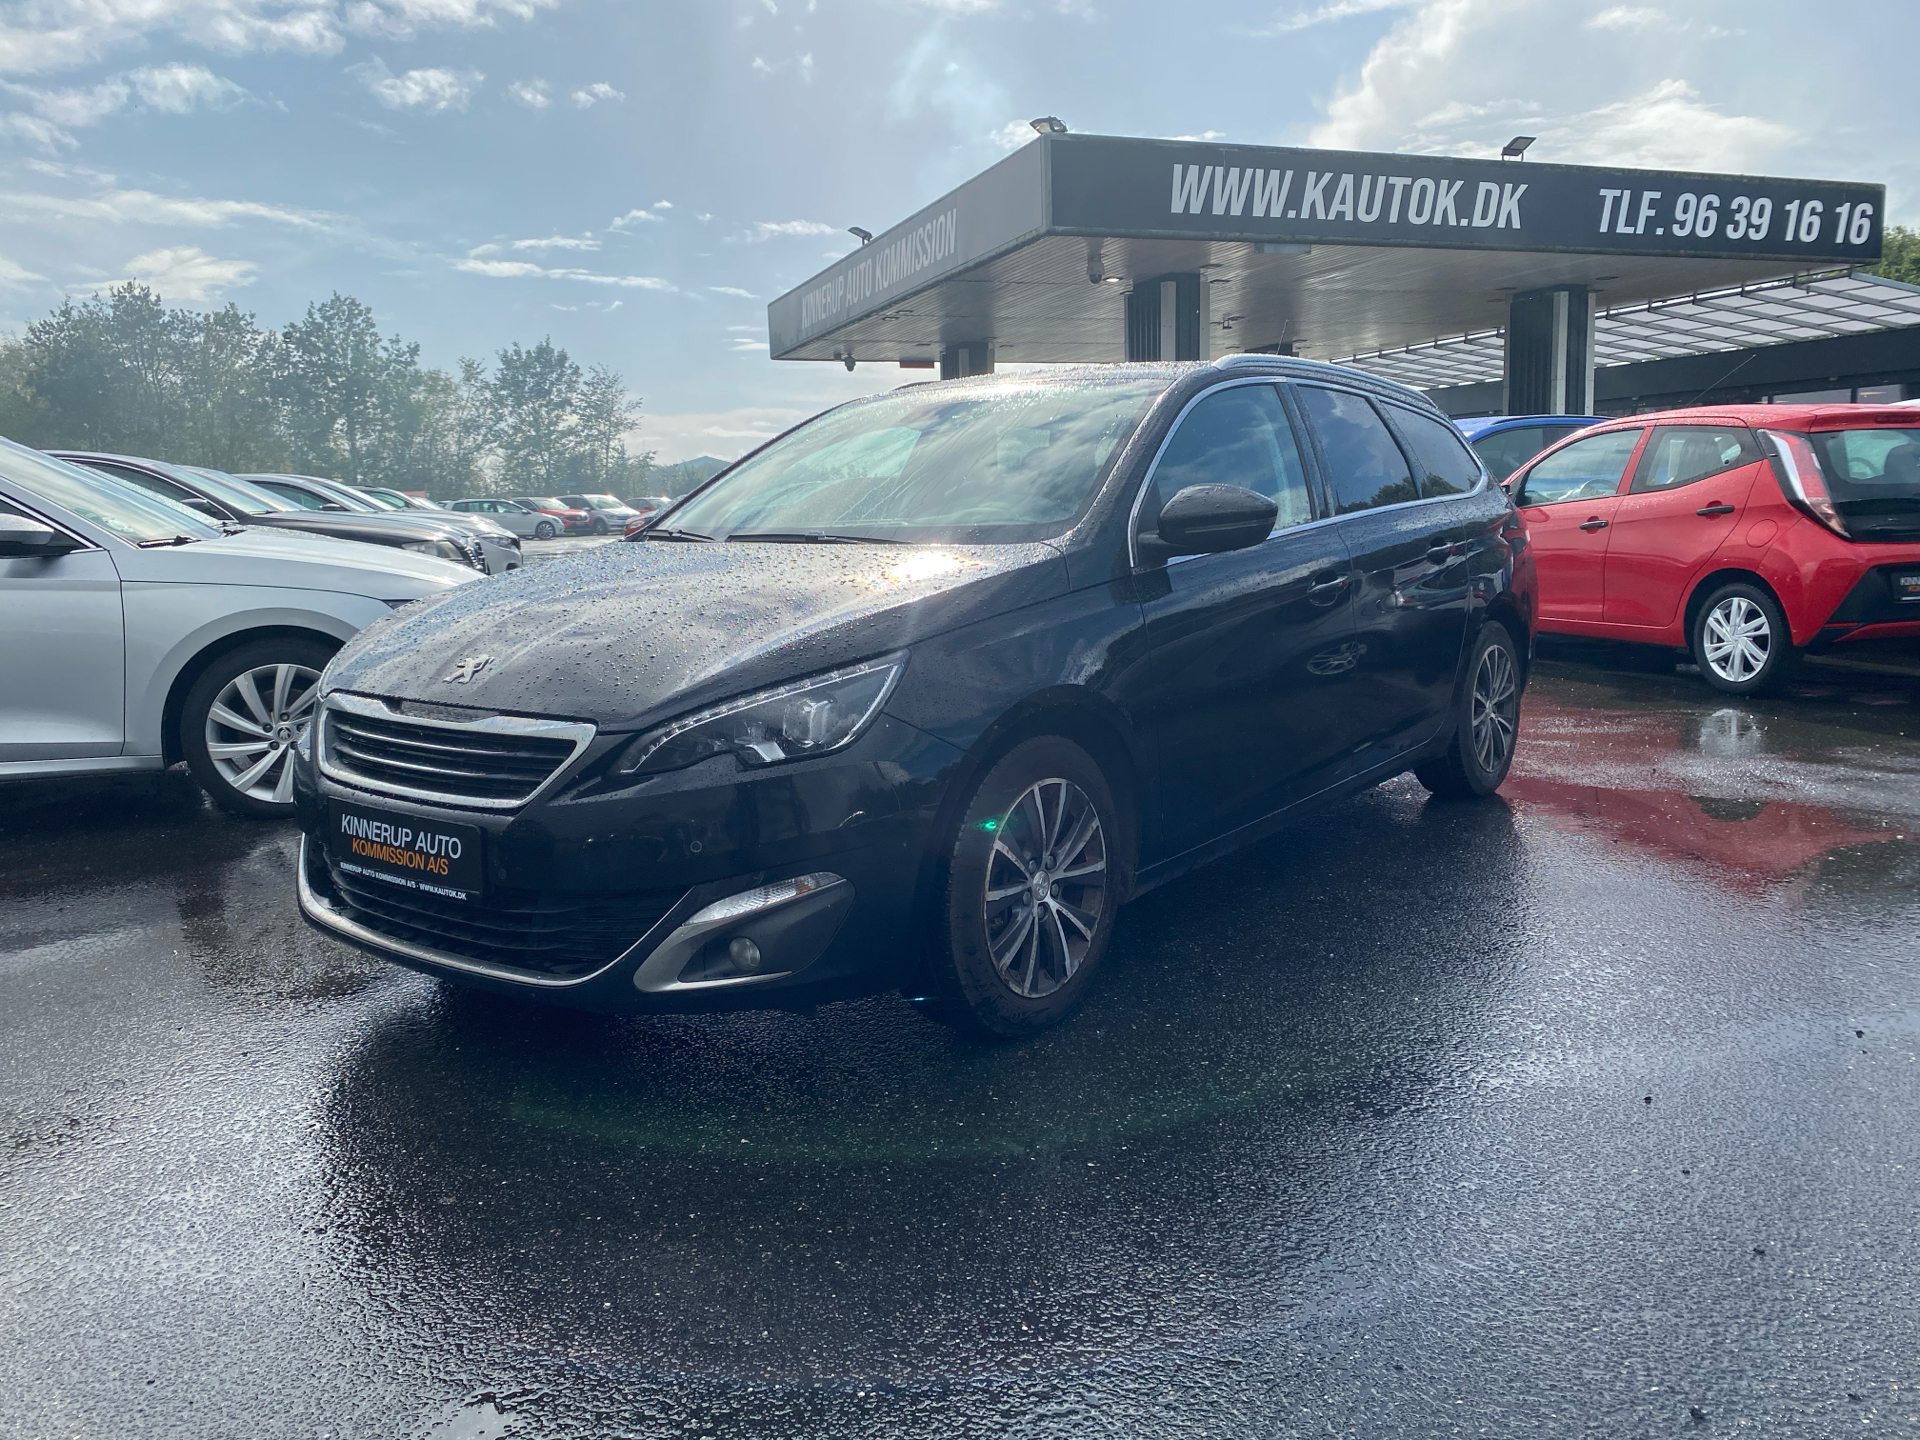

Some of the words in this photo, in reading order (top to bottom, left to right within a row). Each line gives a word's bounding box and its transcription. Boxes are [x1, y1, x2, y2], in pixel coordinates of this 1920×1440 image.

[1171, 164, 1528, 229] WWW.KAUTOK.DK
[1599, 188, 1664, 235] TLF.
[1672, 192, 1721, 238] 96
[1726, 195, 1773, 240] 39
[1784, 199, 1824, 243] 16
[1835, 202, 1874, 245] 16
[802, 275, 844, 330] KINNERUP
[845, 258, 872, 307] AUTO
[875, 208, 957, 293] KOMMISSION
[341, 813, 412, 848] KINNERUP
[415, 831, 462, 859] AUTO
[352, 837, 424, 870] KOMMISSION
[427, 855, 449, 875] A/S
[363, 868, 375, 877] AUTO
[419, 883, 467, 900] WWW.KAUTOK.DK
